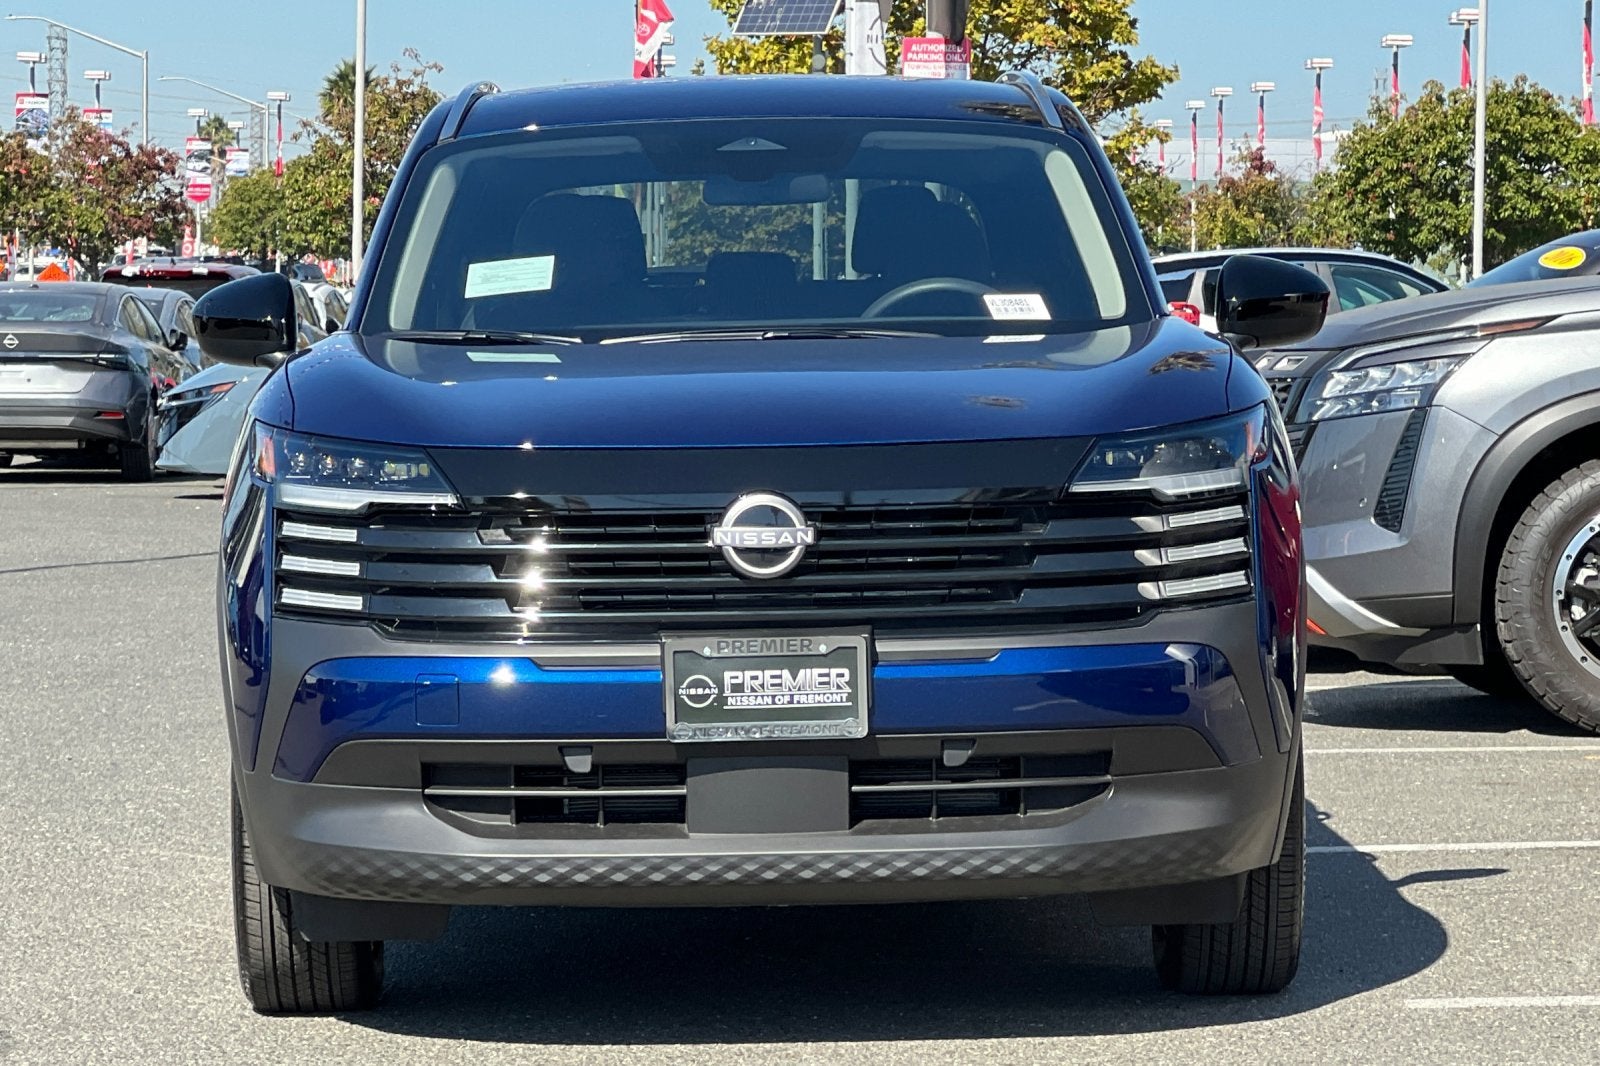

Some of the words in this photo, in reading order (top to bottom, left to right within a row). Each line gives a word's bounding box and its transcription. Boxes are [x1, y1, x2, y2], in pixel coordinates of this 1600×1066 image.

[911, 43, 963, 53] AUTHORIZED
[907, 52, 943, 61] PARKING
[945, 53, 967, 62] ONLY
[715, 530, 813, 545] NISSAN
[716, 638, 813, 655] PREMIER
[723, 668, 852, 693] PREMIER
[678, 687, 719, 695] NISSAN
[727, 695, 772, 706] NISSAN
[774, 694, 791, 705] OF
[793, 693, 849, 704] FREMONT
[694, 726, 747, 739] NISSAN
[751, 725, 770, 738] OF
[772, 724, 841, 737] FREMONT
